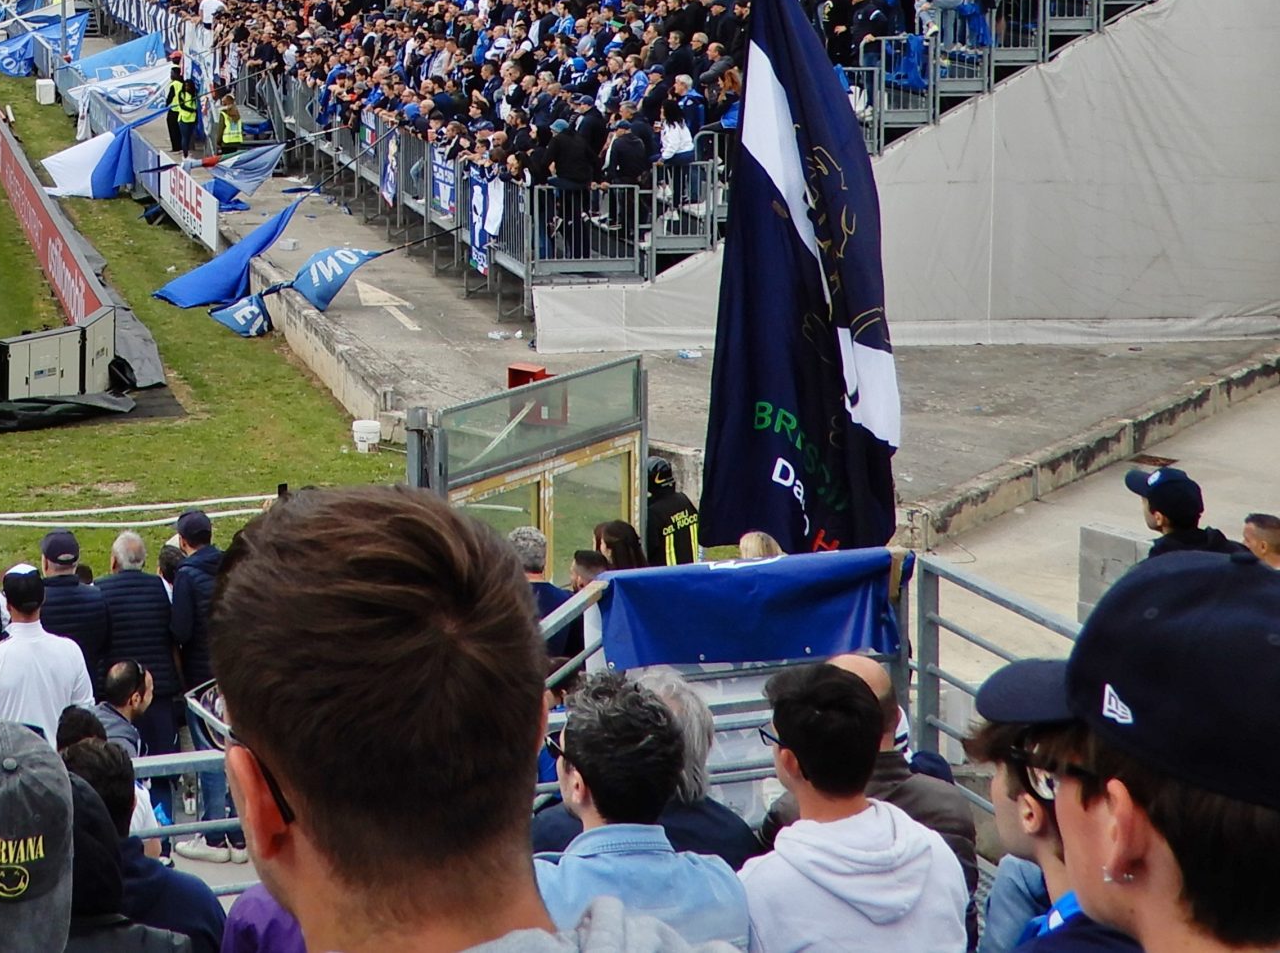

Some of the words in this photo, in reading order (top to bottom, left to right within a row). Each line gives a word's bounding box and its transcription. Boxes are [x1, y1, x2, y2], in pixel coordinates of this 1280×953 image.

[169, 166, 203, 222] GIELLE
[662, 524, 676, 536] DEL
[676, 513, 699, 530] FUOCO
